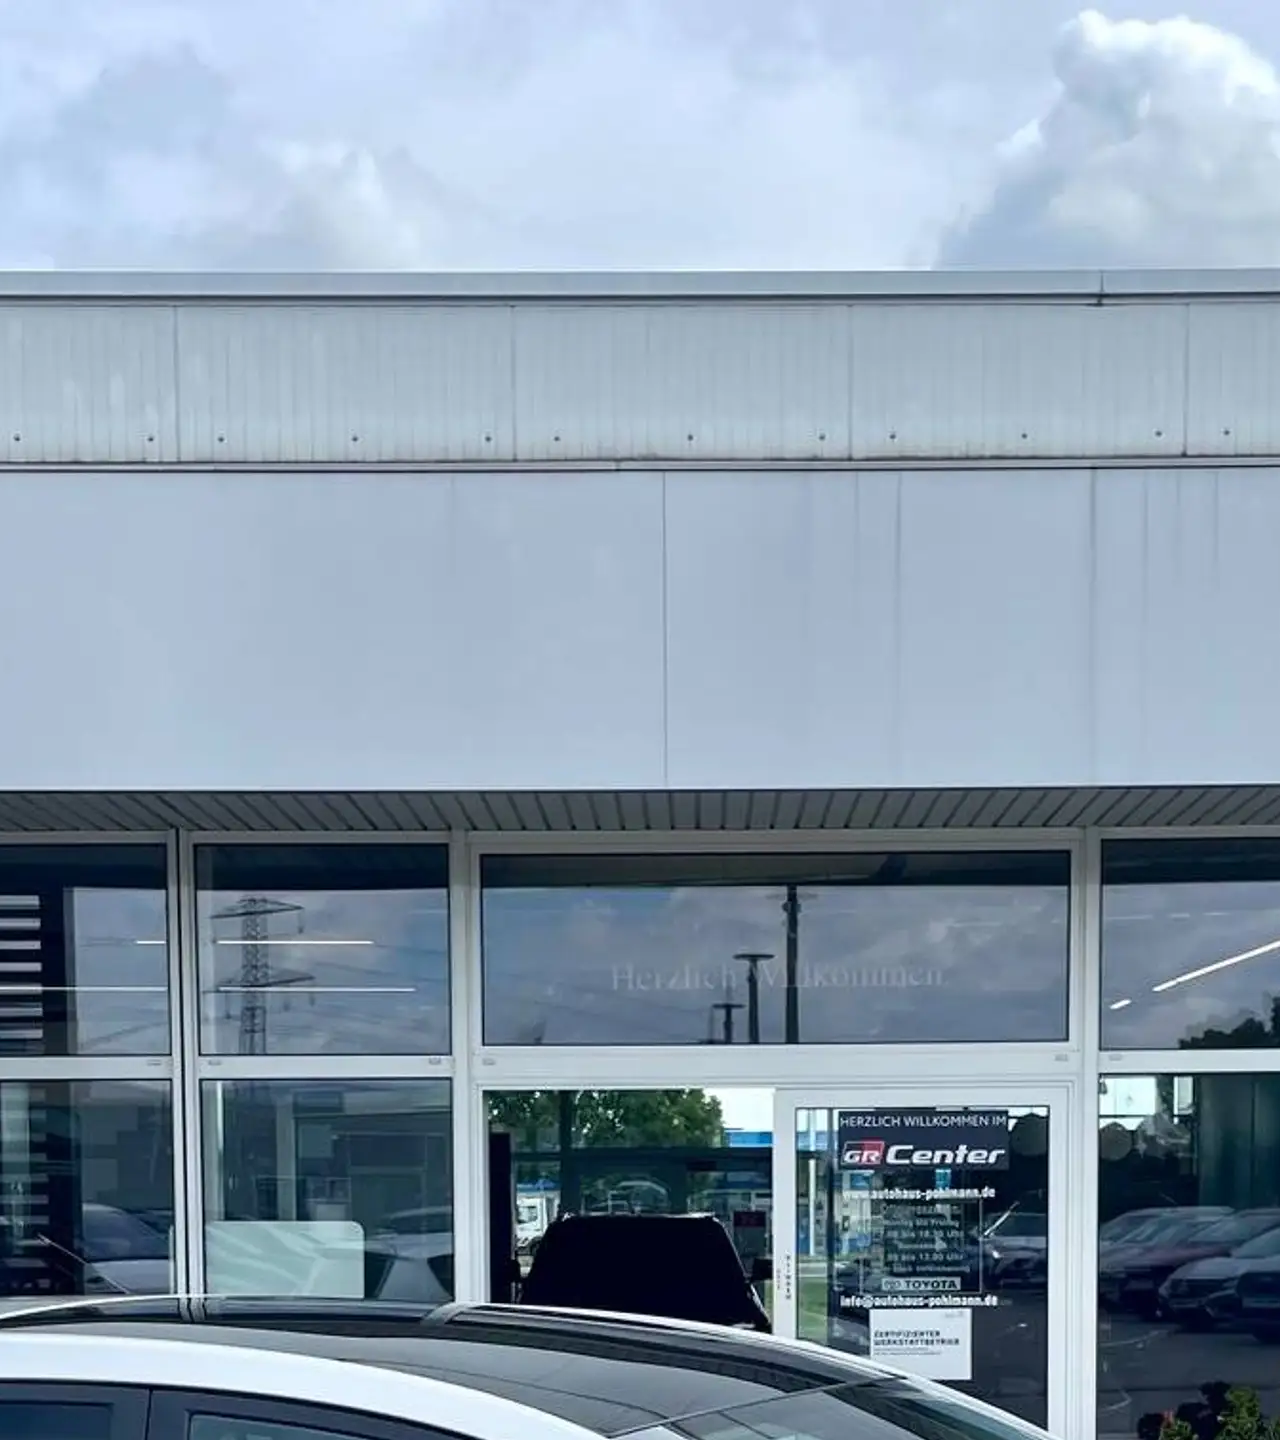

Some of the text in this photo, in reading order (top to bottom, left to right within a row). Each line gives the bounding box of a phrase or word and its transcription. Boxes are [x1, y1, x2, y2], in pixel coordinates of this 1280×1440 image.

[840, 1115, 1007, 1128] HERZLICH WILLKOMMEN IM
[842, 1144, 1007, 1165] GR Center
[904, 1279, 958, 1290] TOYOTA
